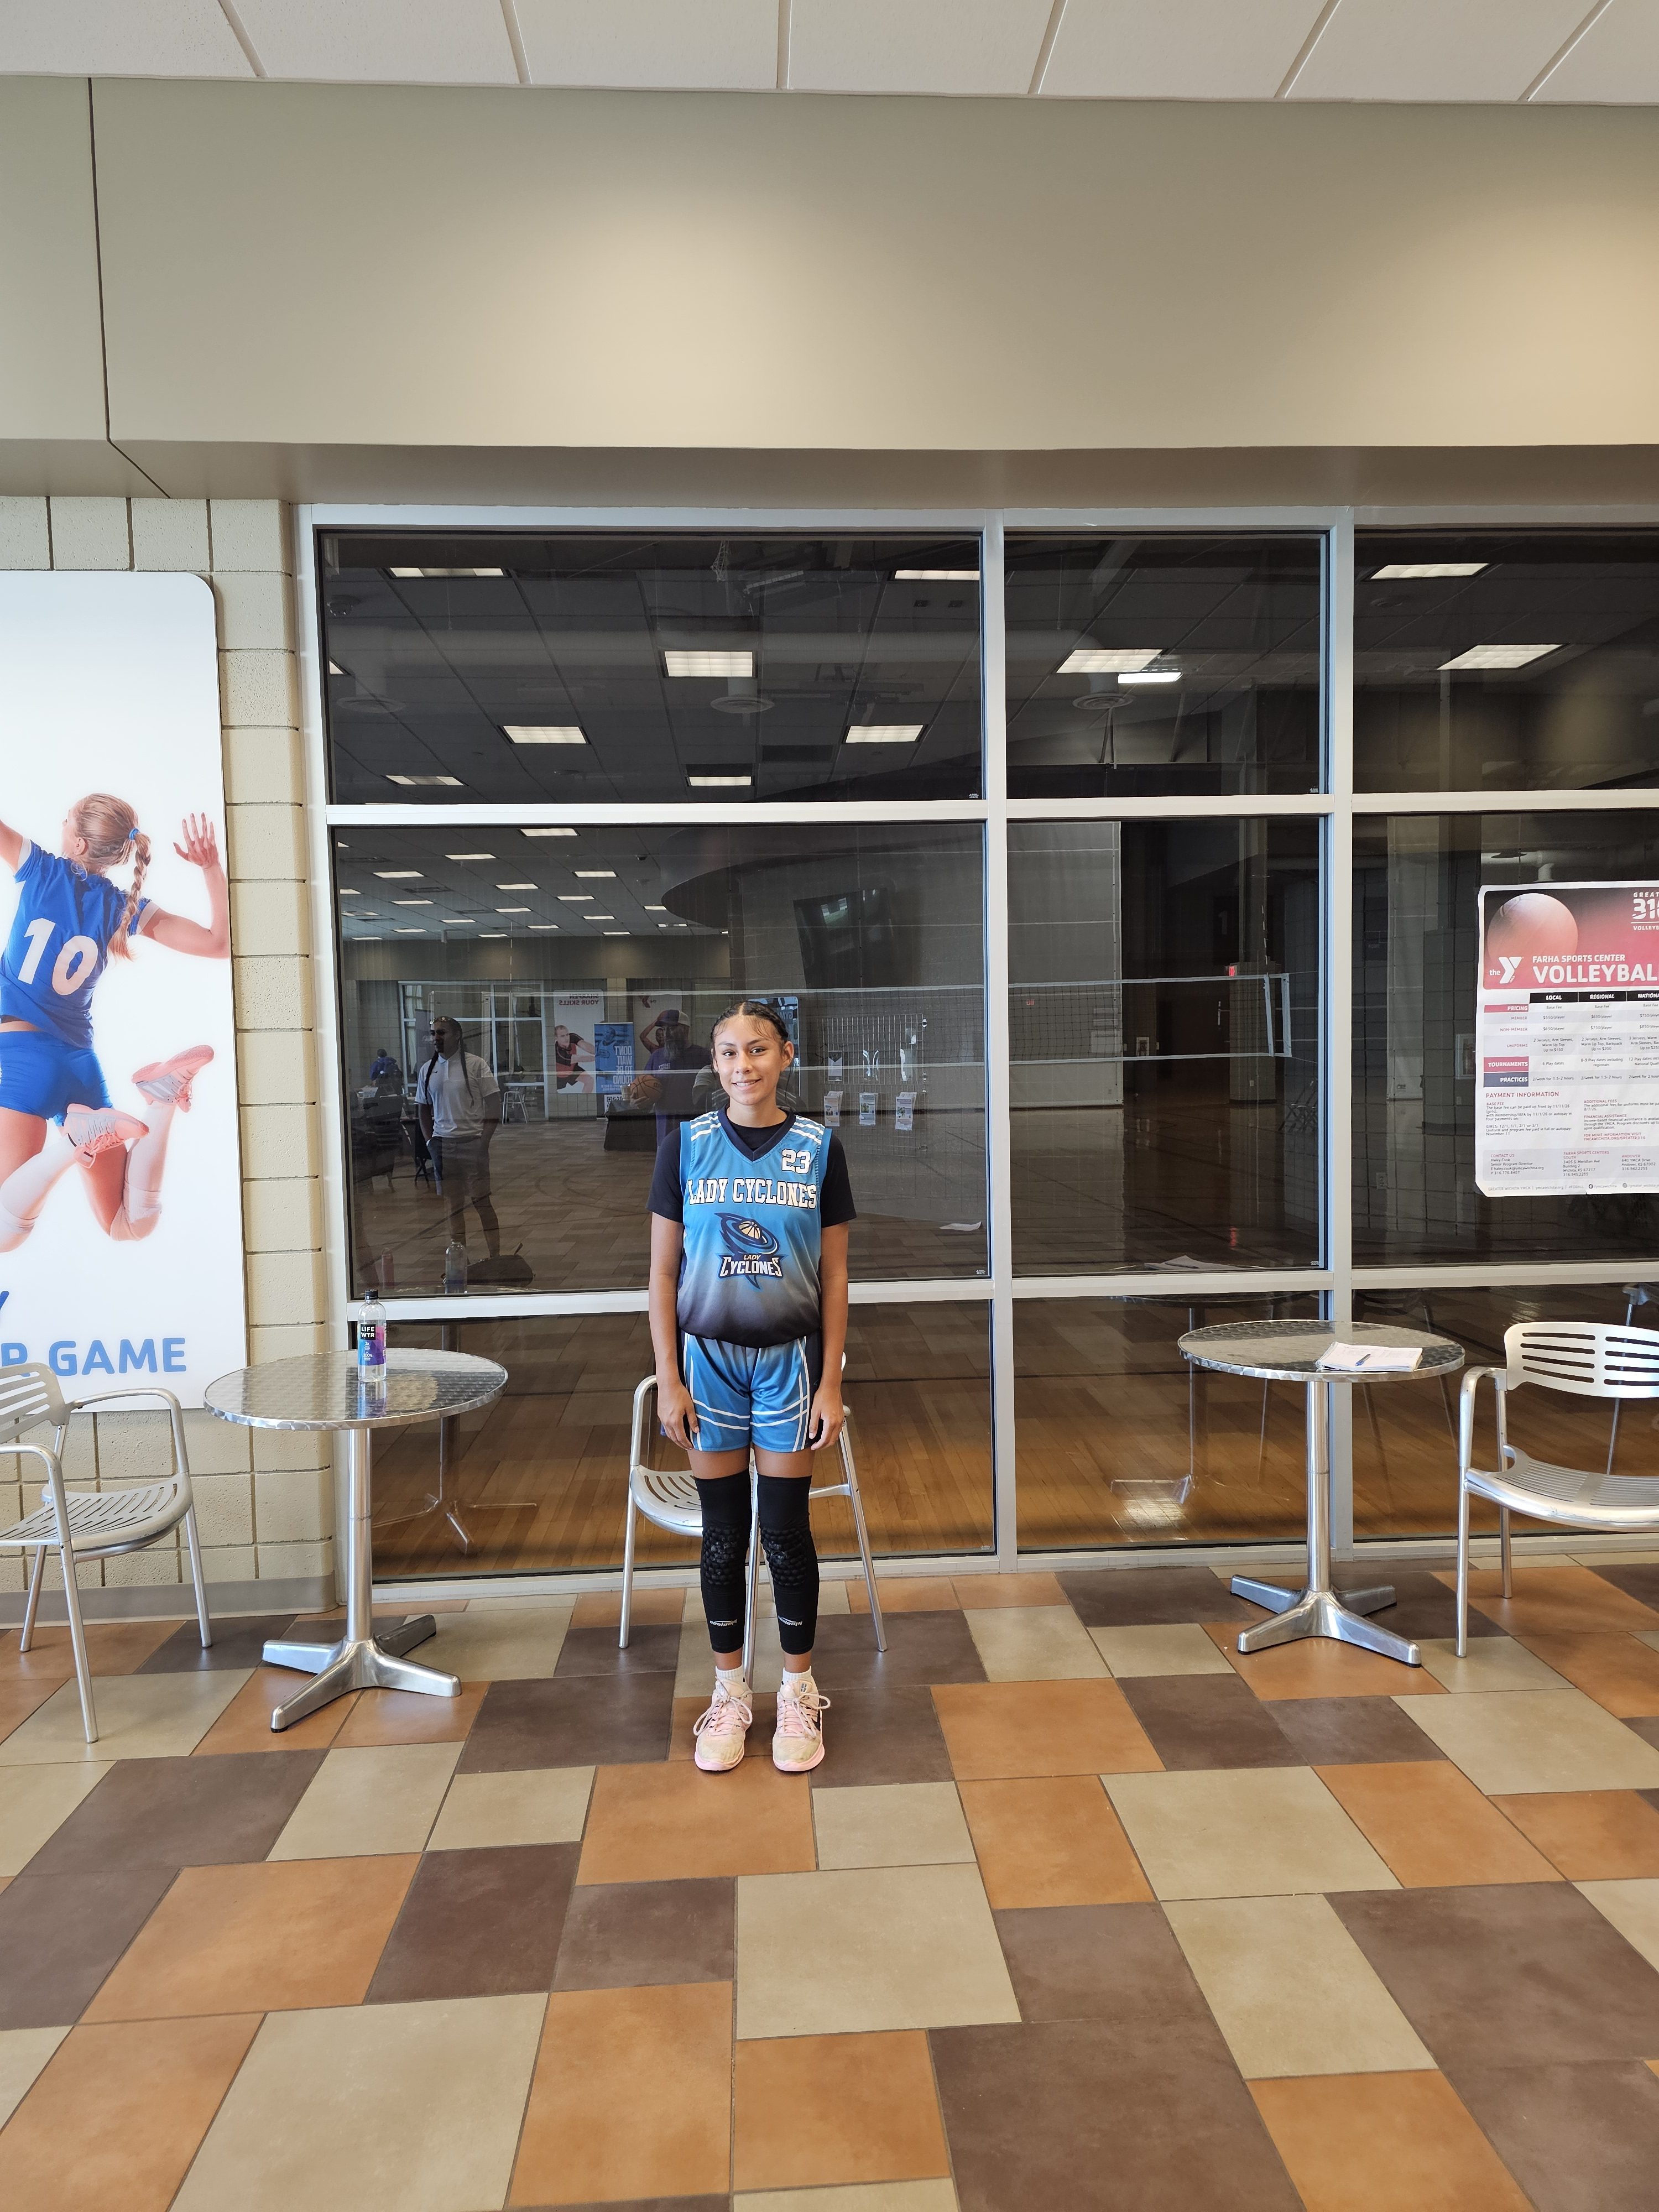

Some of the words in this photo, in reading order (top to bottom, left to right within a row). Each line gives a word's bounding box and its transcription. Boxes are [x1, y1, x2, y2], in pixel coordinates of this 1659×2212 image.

[18, 917, 98, 995] 10
[781, 1149, 811, 1173] 23
[688, 1178, 728, 1206] LADY
[733, 1178, 816, 1209] CYCLONES
[720, 1257, 782, 1277] CYCLONES
[49, 1337, 186, 1376] GAME
